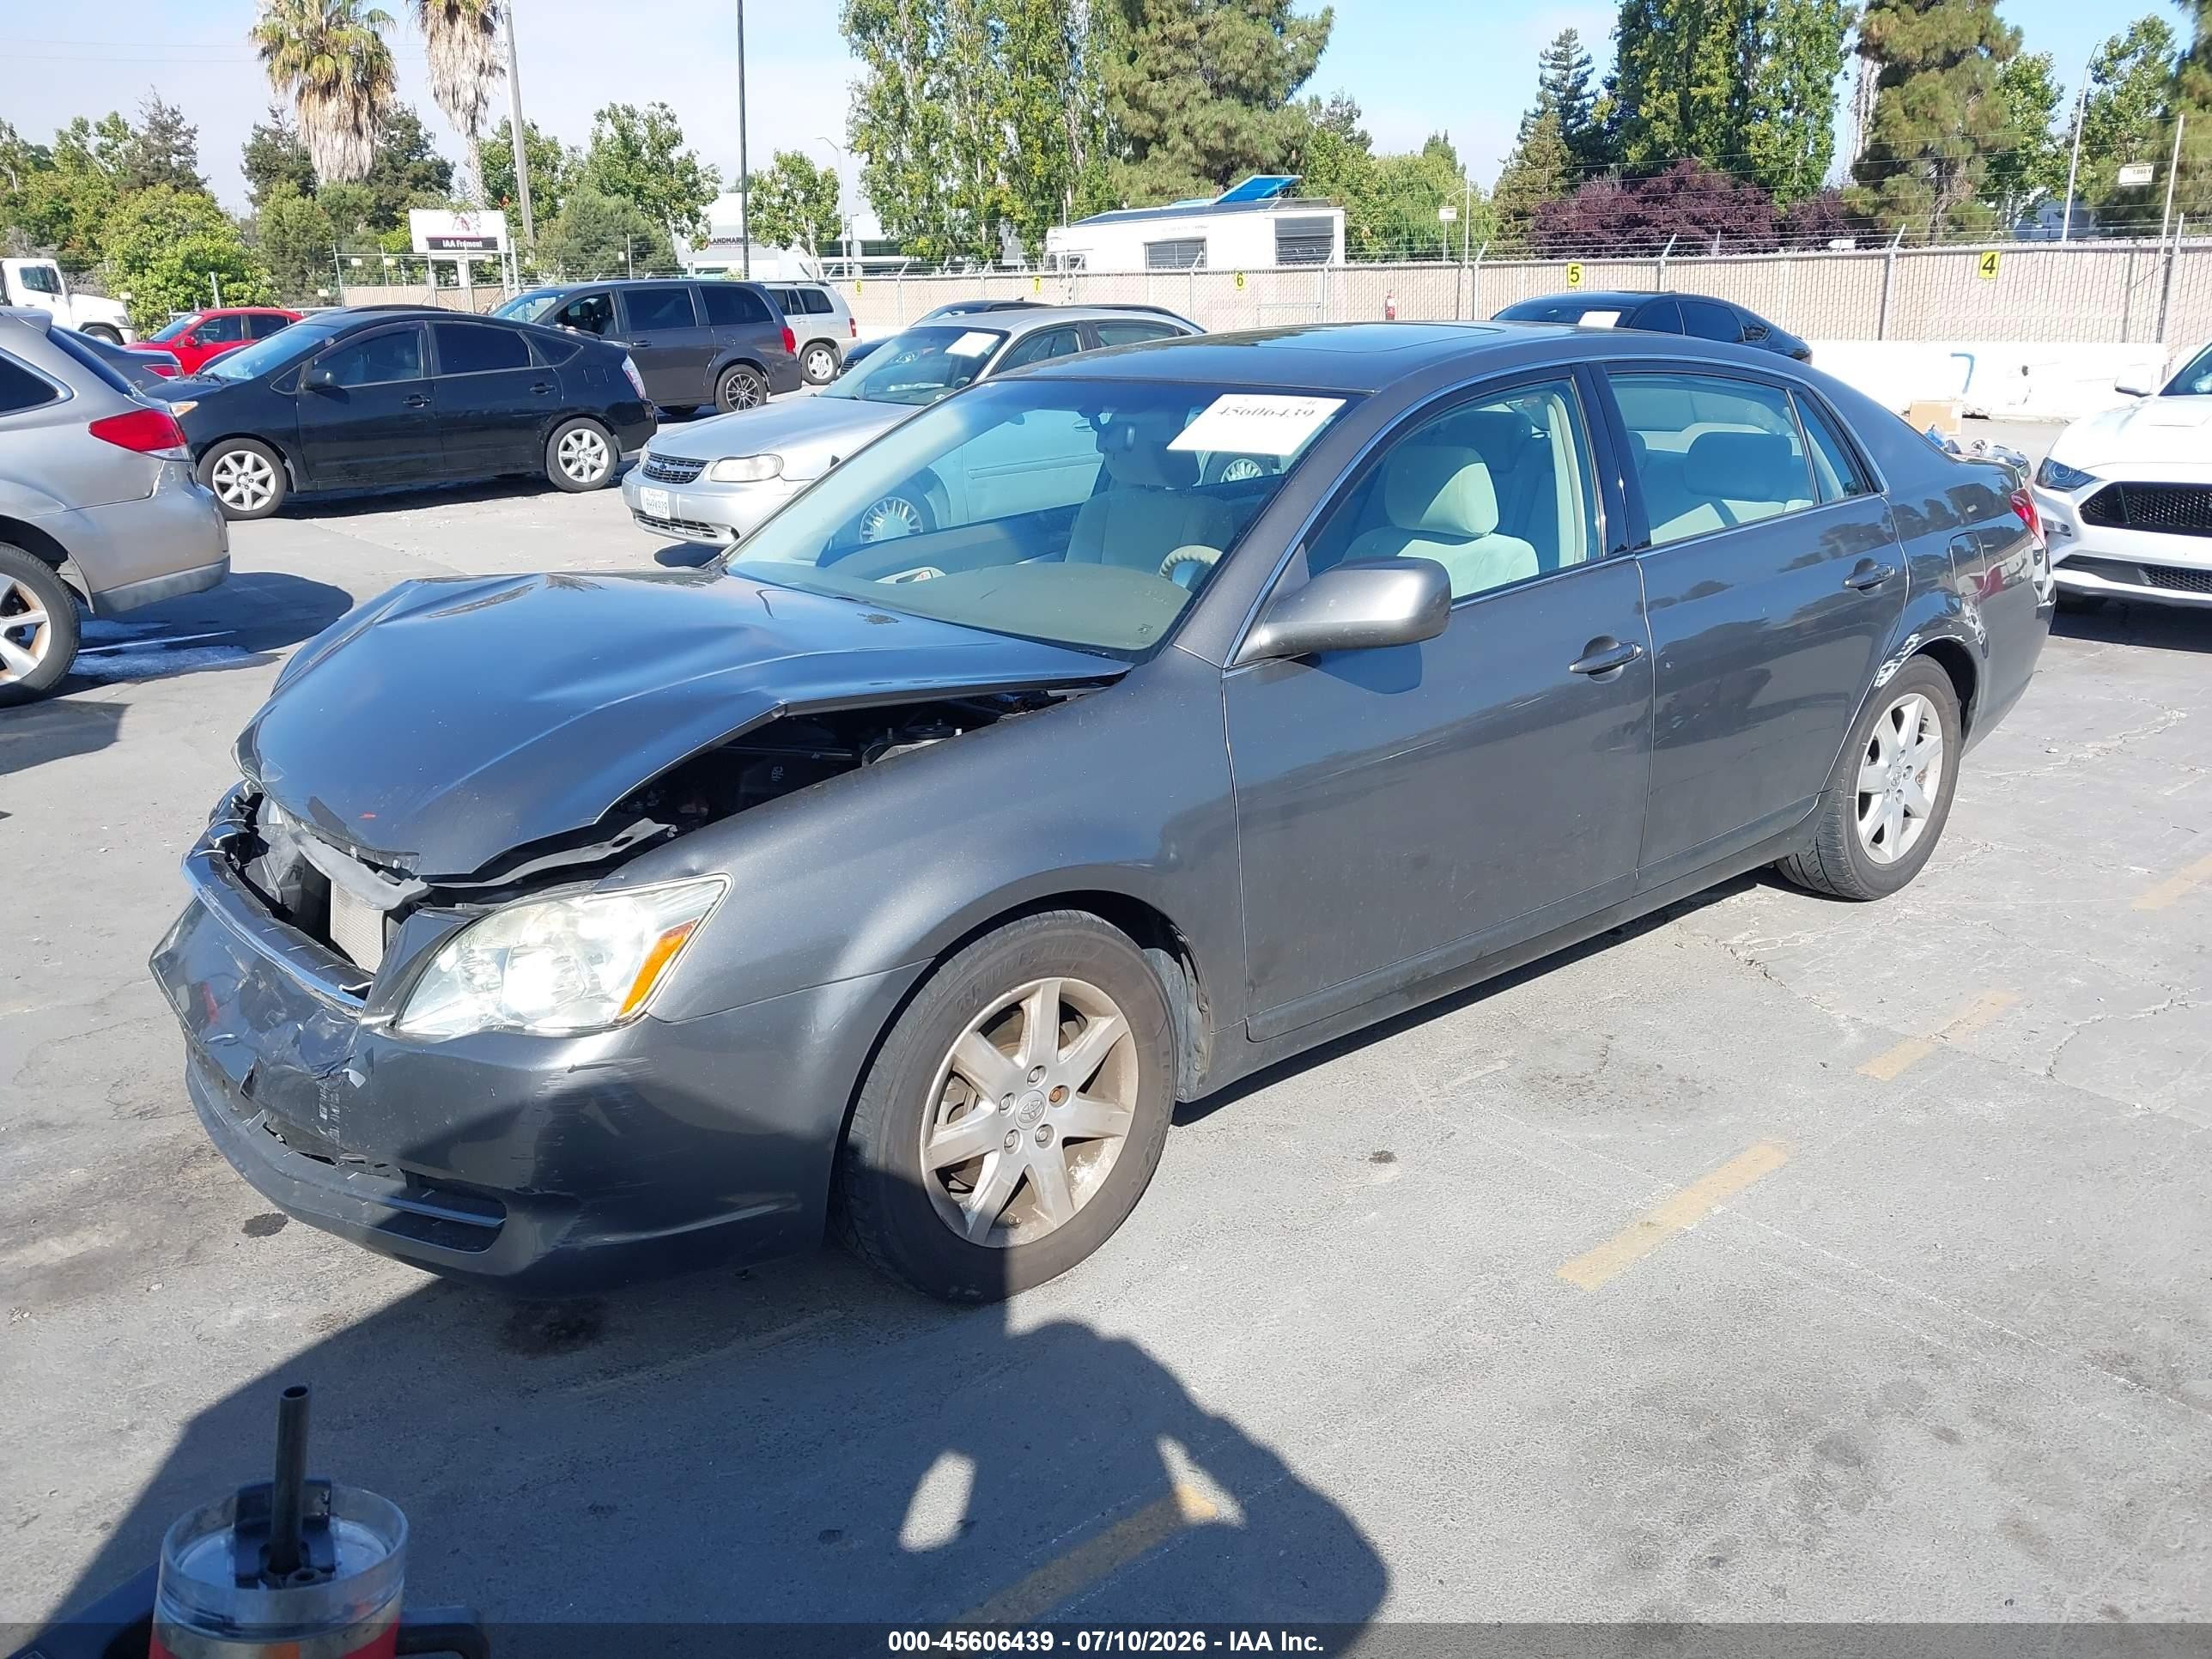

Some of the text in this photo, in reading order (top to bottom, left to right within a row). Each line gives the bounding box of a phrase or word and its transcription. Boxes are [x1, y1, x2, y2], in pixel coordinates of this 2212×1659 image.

[1982, 254, 1996, 274] 4
[1237, 272, 1243, 287] 6
[1571, 266, 1580, 283] 5
[1034, 278, 1040, 291] 7
